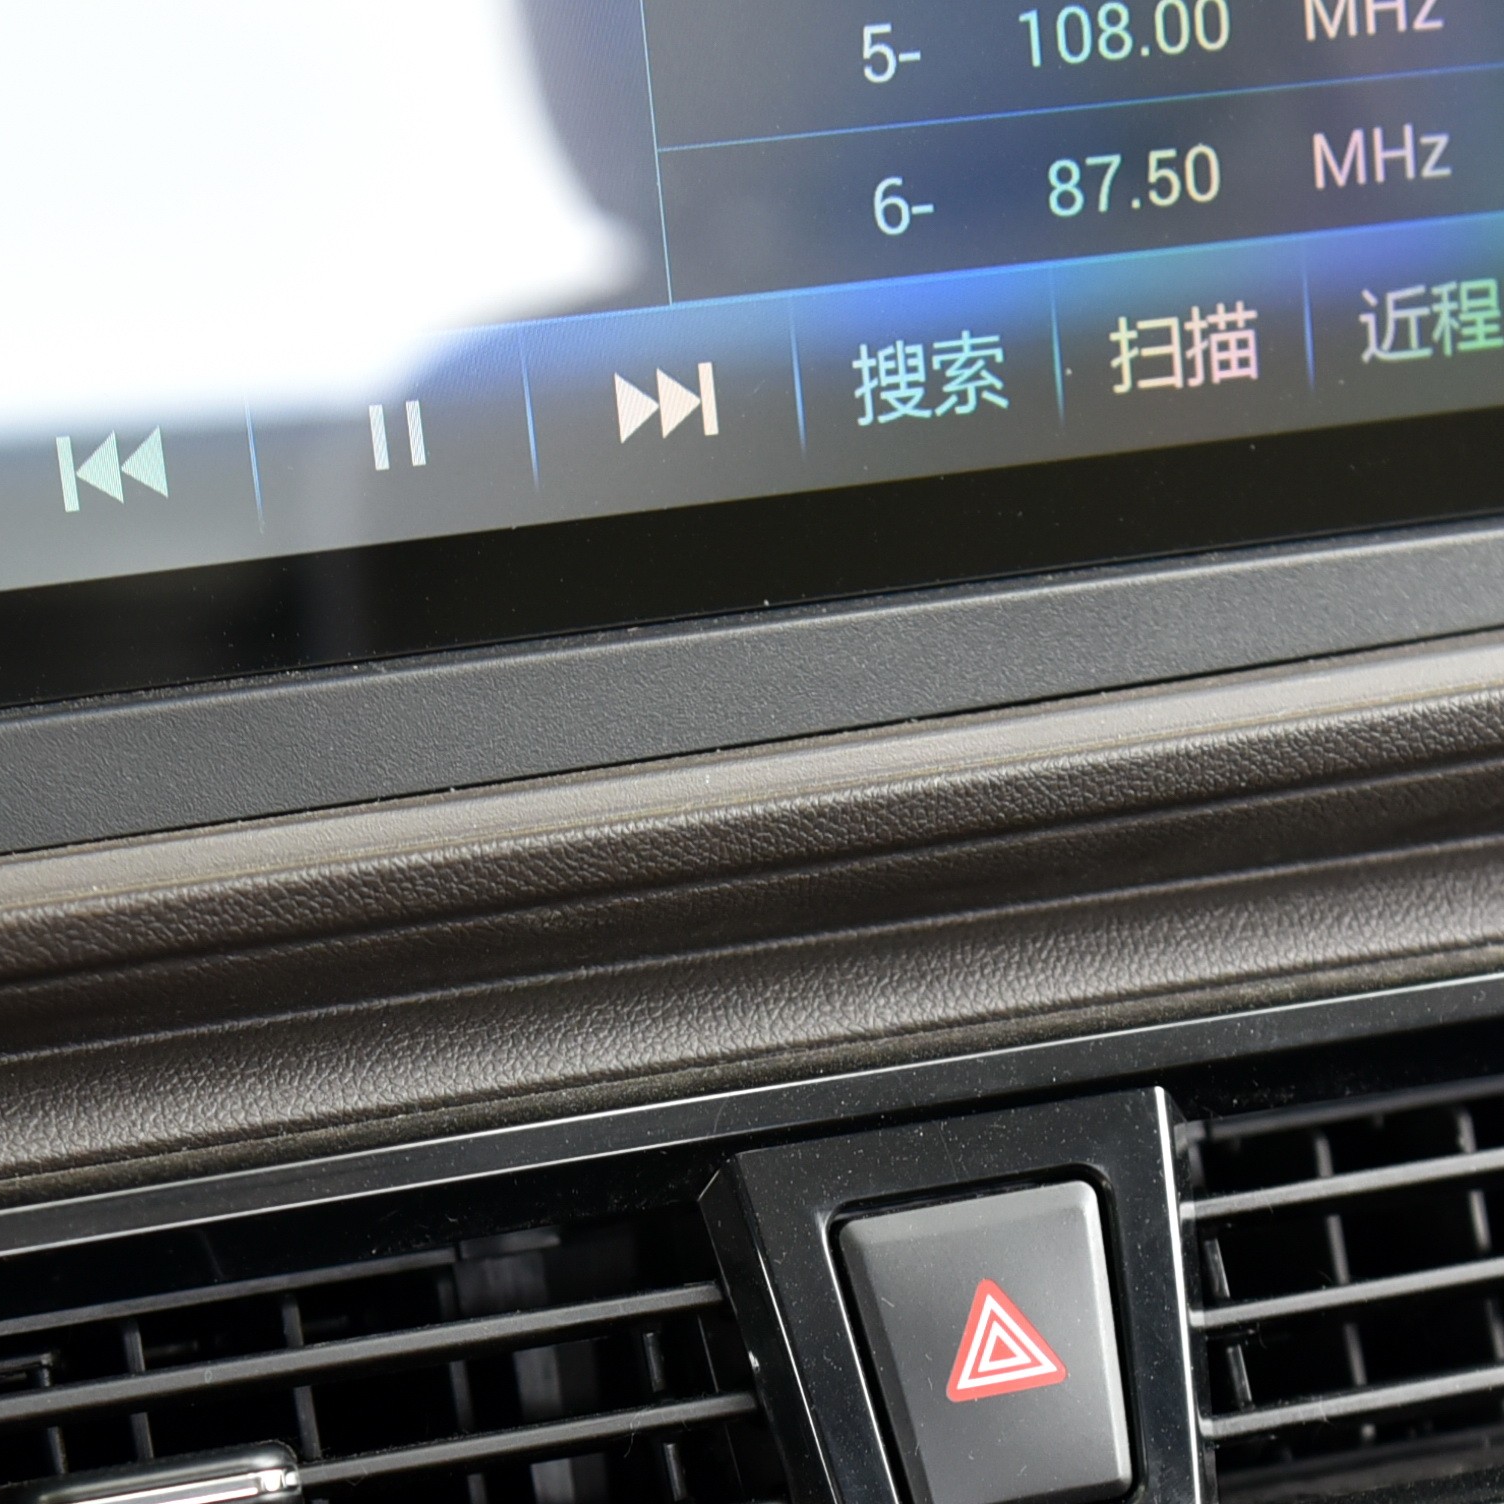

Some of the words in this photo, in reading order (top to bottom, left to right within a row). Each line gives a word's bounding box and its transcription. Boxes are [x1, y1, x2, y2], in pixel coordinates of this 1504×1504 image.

[860, 23, 921, 83] 5-
[1017, 0, 1232, 68] 108.00
[872, 176, 935, 235] 6-
[1047, 143, 1222, 217] 87.50
[1312, 124, 1453, 190] MHz
[851, 330, 1010, 426] 搜索
[1108, 301, 1259, 394] 扫描
